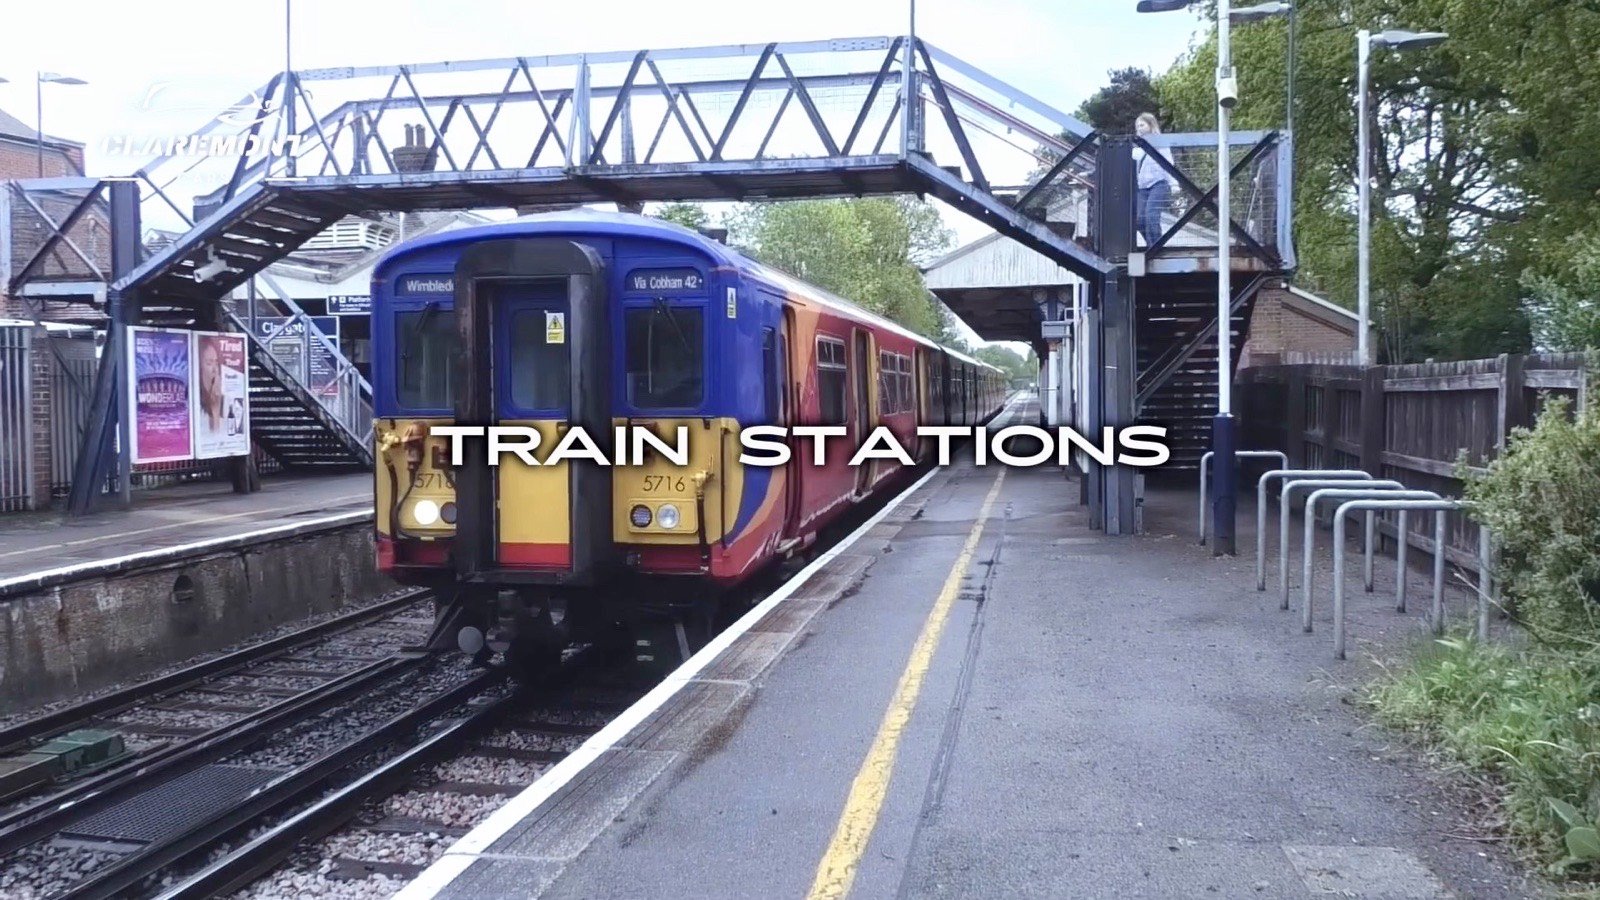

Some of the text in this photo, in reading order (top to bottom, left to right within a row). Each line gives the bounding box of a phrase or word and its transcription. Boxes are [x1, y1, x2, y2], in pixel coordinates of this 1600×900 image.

[634, 276, 697, 289] Via Cobham 42
[643, 475, 685, 492] 5716
